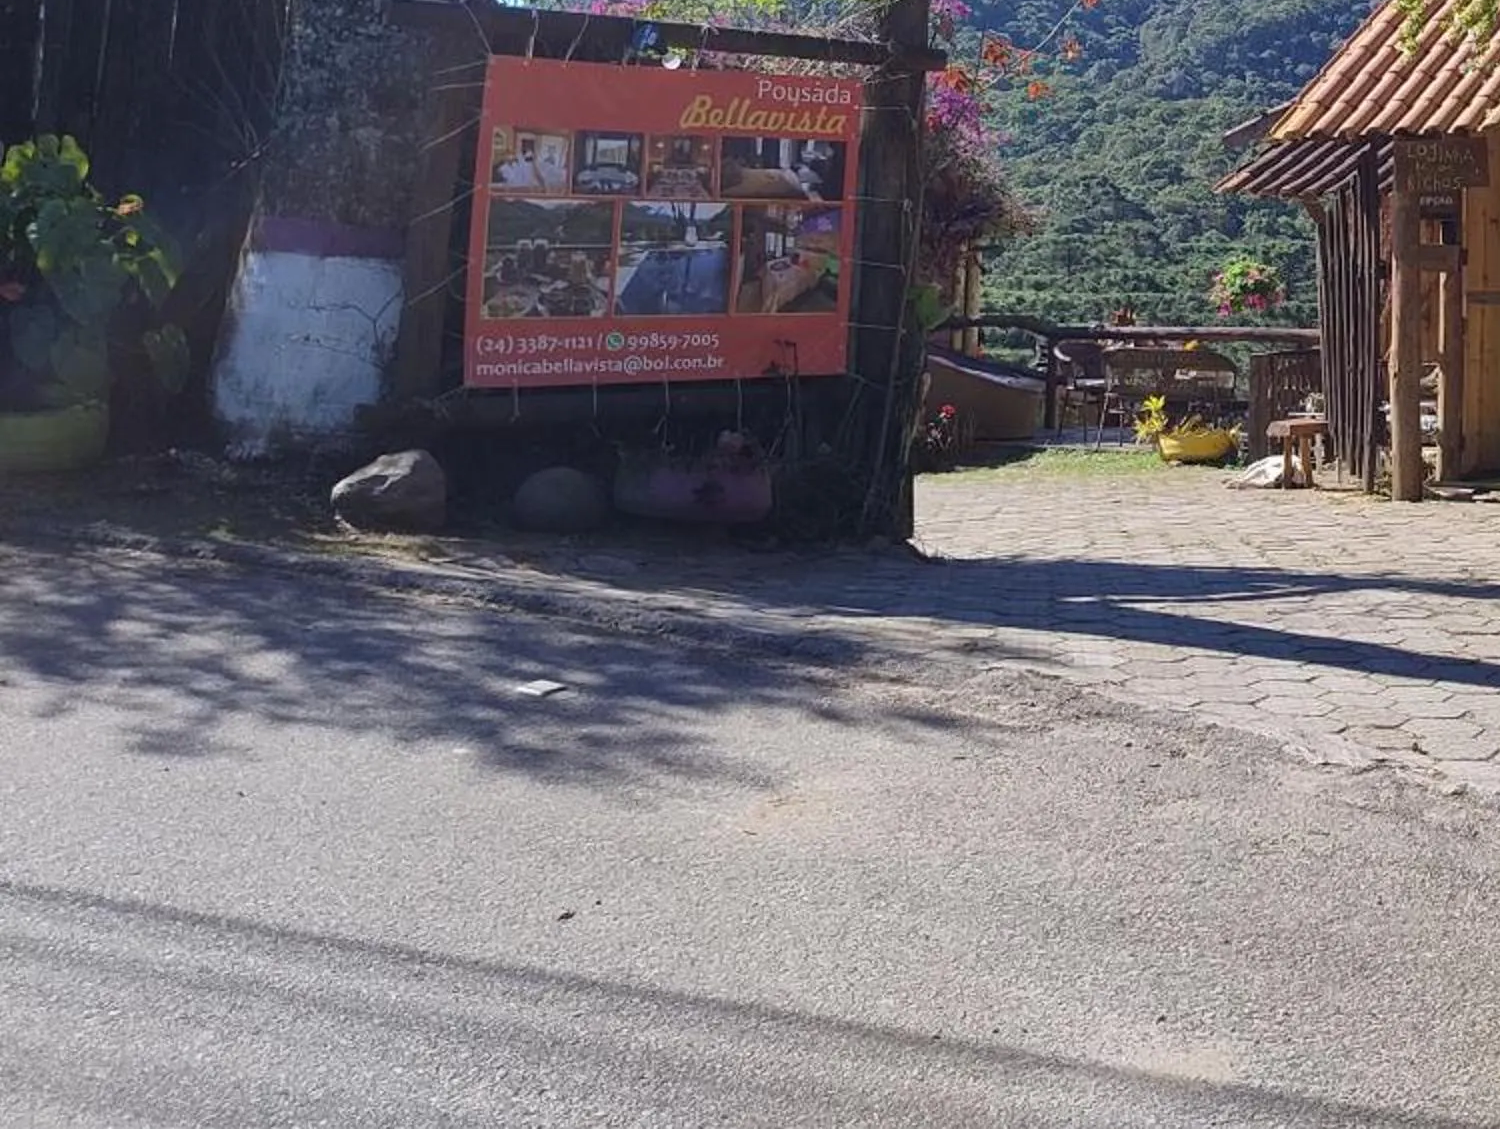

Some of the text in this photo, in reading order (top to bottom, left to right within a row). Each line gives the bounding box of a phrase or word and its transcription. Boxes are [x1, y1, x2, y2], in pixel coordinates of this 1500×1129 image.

[757, 78, 852, 108] Pousada
[679, 94, 848, 135] Bellavista
[476, 335, 514, 354] (24)
[517, 334, 593, 354] 3387-1121
[627, 332, 720, 349] 99859-7005
[476, 353, 725, 376] monicabellavista@bol.com.br
